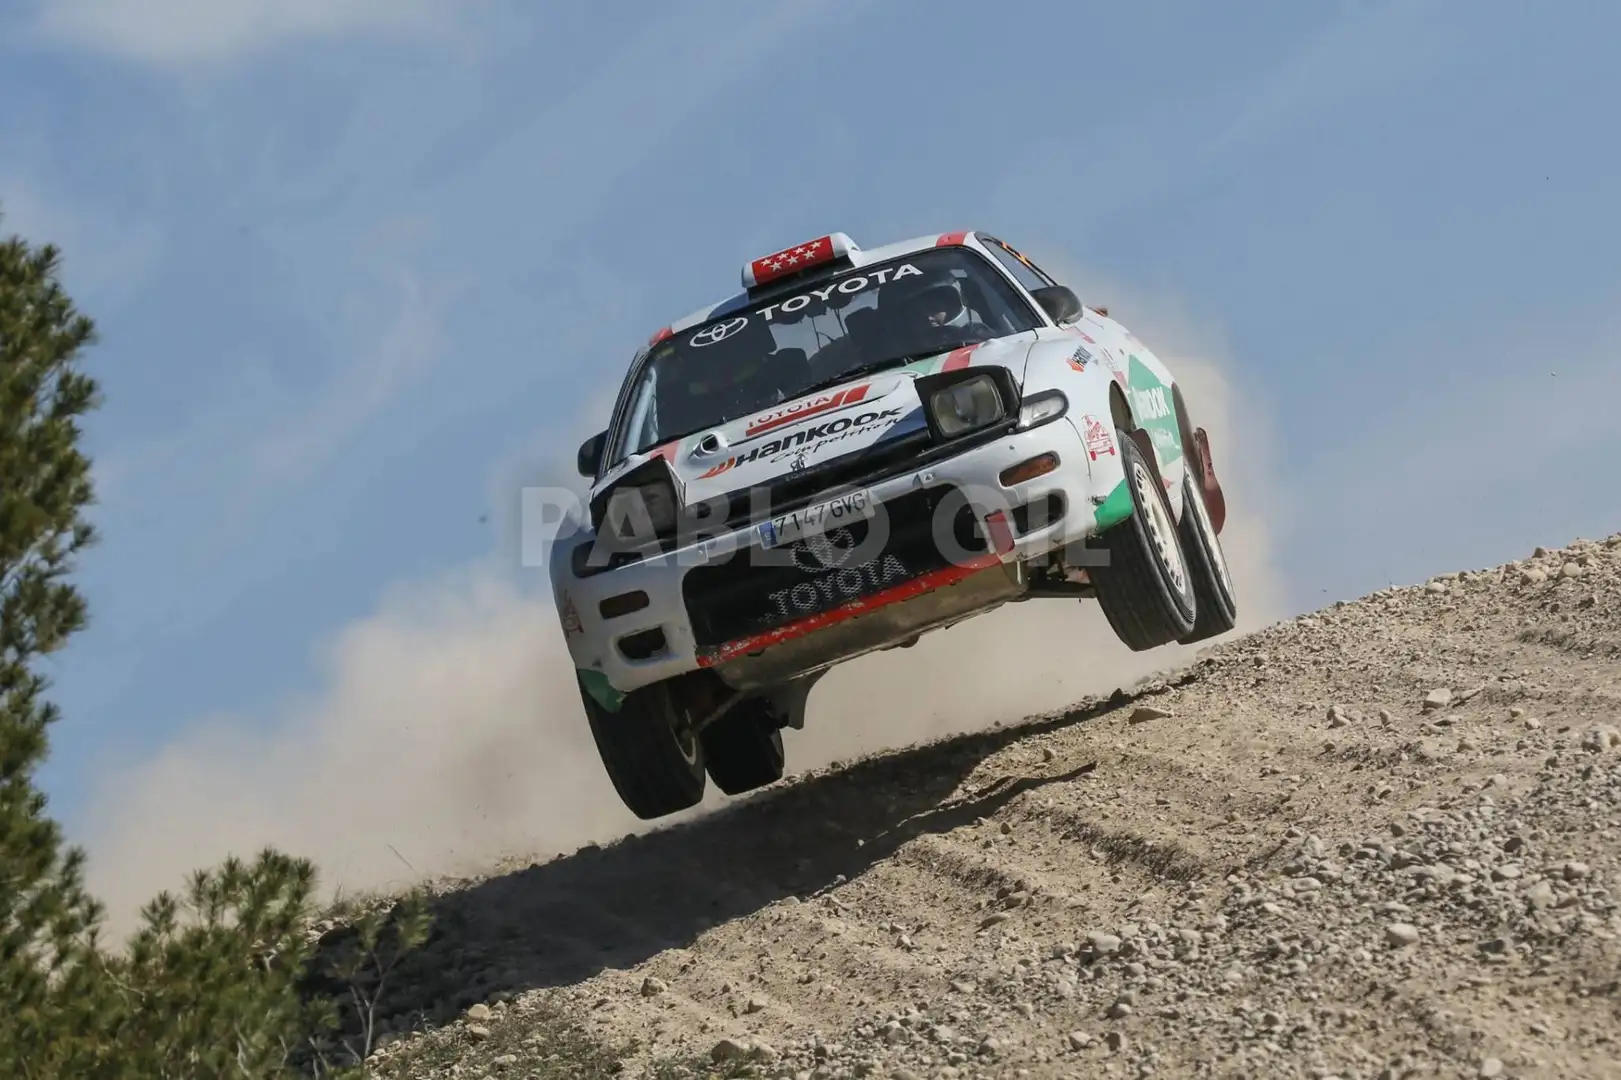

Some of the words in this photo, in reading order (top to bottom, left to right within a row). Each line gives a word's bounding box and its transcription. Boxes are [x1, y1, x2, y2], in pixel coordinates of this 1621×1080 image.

[756, 263, 924, 321] TOYOTA
[748, 396, 834, 428] TOYOTA
[776, 505, 825, 537] 7147
[830, 493, 866, 518] GVG
[769, 554, 908, 616] TOYOTA
